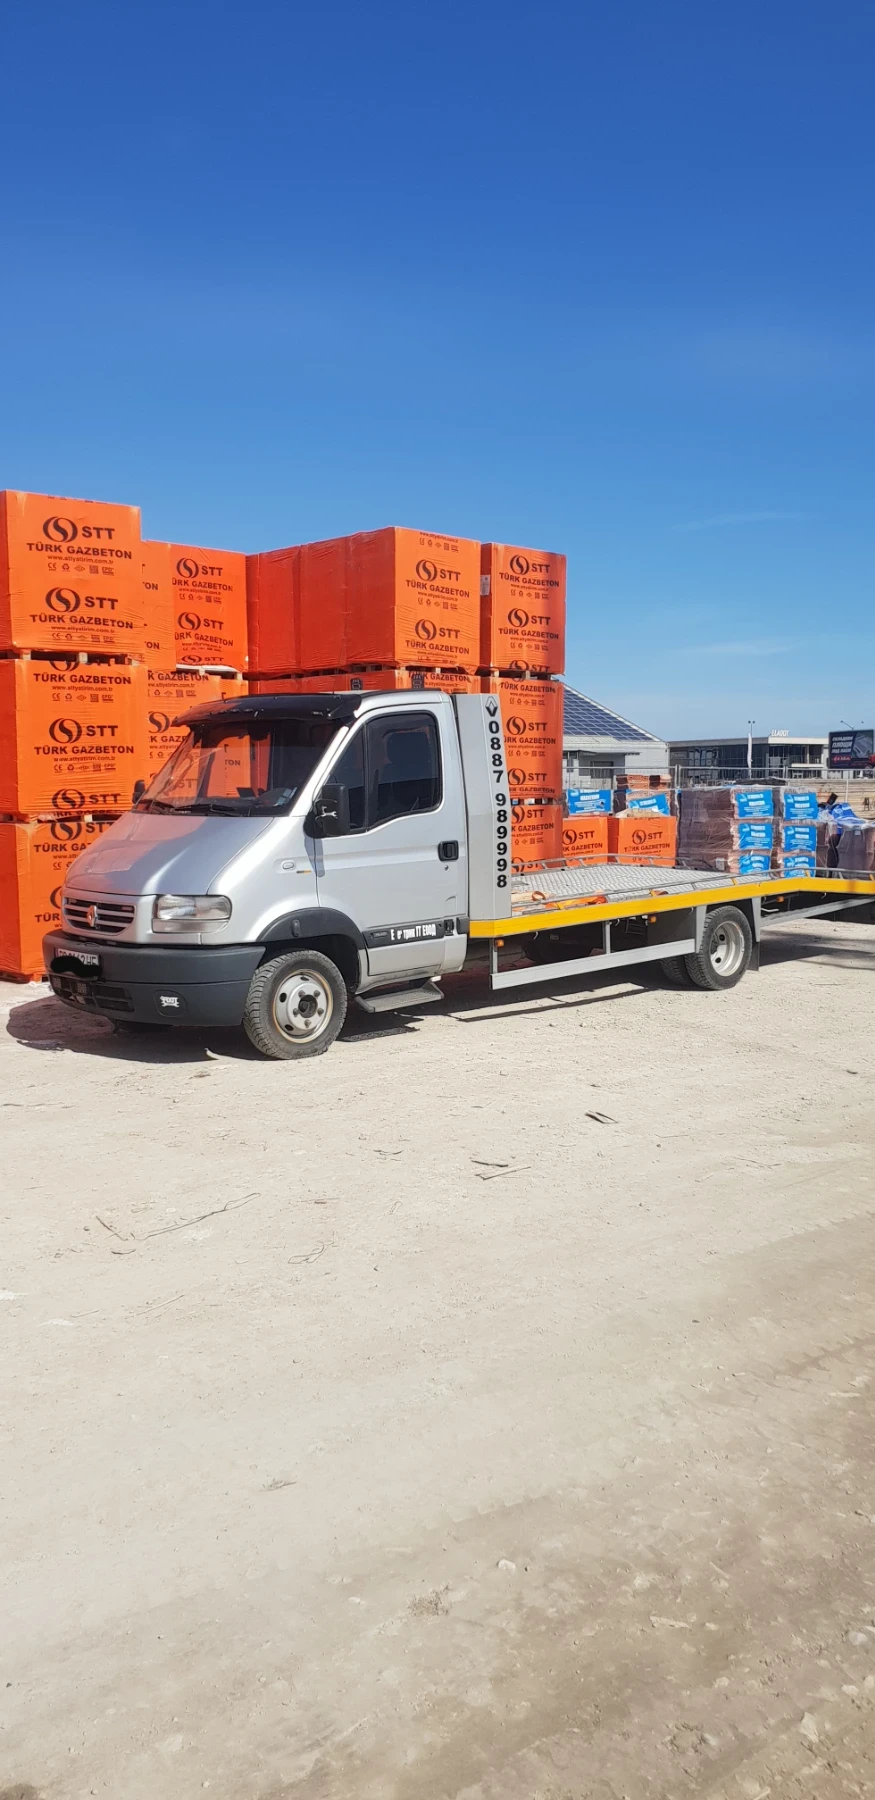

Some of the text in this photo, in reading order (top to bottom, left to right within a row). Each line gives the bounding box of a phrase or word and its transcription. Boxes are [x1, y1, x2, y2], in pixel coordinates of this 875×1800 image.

[82, 526, 115, 539] STT
[26, 542, 132, 559] TÜRK GAZBETON
[201, 566, 223, 576] STT
[532, 563, 550, 573] STT
[440, 569, 461, 582] STT
[499, 572, 559, 587] TÜRK GAZBETON
[192, 580, 233, 592] GAZBETON
[406, 579, 427, 590] TÜRK
[430, 583, 470, 598] GAZBETON
[85, 596, 118, 610] STT
[30, 613, 133, 629] TÜRK GAZBETON
[203, 619, 224, 630] STT
[531, 616, 551, 625] STT
[439, 628, 460, 639] STT
[521, 630, 559, 640] GAZBETON
[194, 633, 234, 646] GAZBETON
[405, 639, 469, 654] TÜRK GAZBETON
[33, 672, 131, 684] TÜRK GAZBETON
[499, 681, 556, 693] TÜRK GAZBETON
[86, 725, 118, 737] STT
[528, 722, 547, 731] STT
[34, 745, 68, 755] TÜRK
[528, 773, 547, 781] STT
[89, 793, 121, 804] STT
[527, 809, 544, 818] STT
[518, 823, 554, 831] GAZBETON
[579, 831, 595, 840] STT
[34, 843, 67, 852] TÜRK
[35, 913, 60, 922] TÜR
